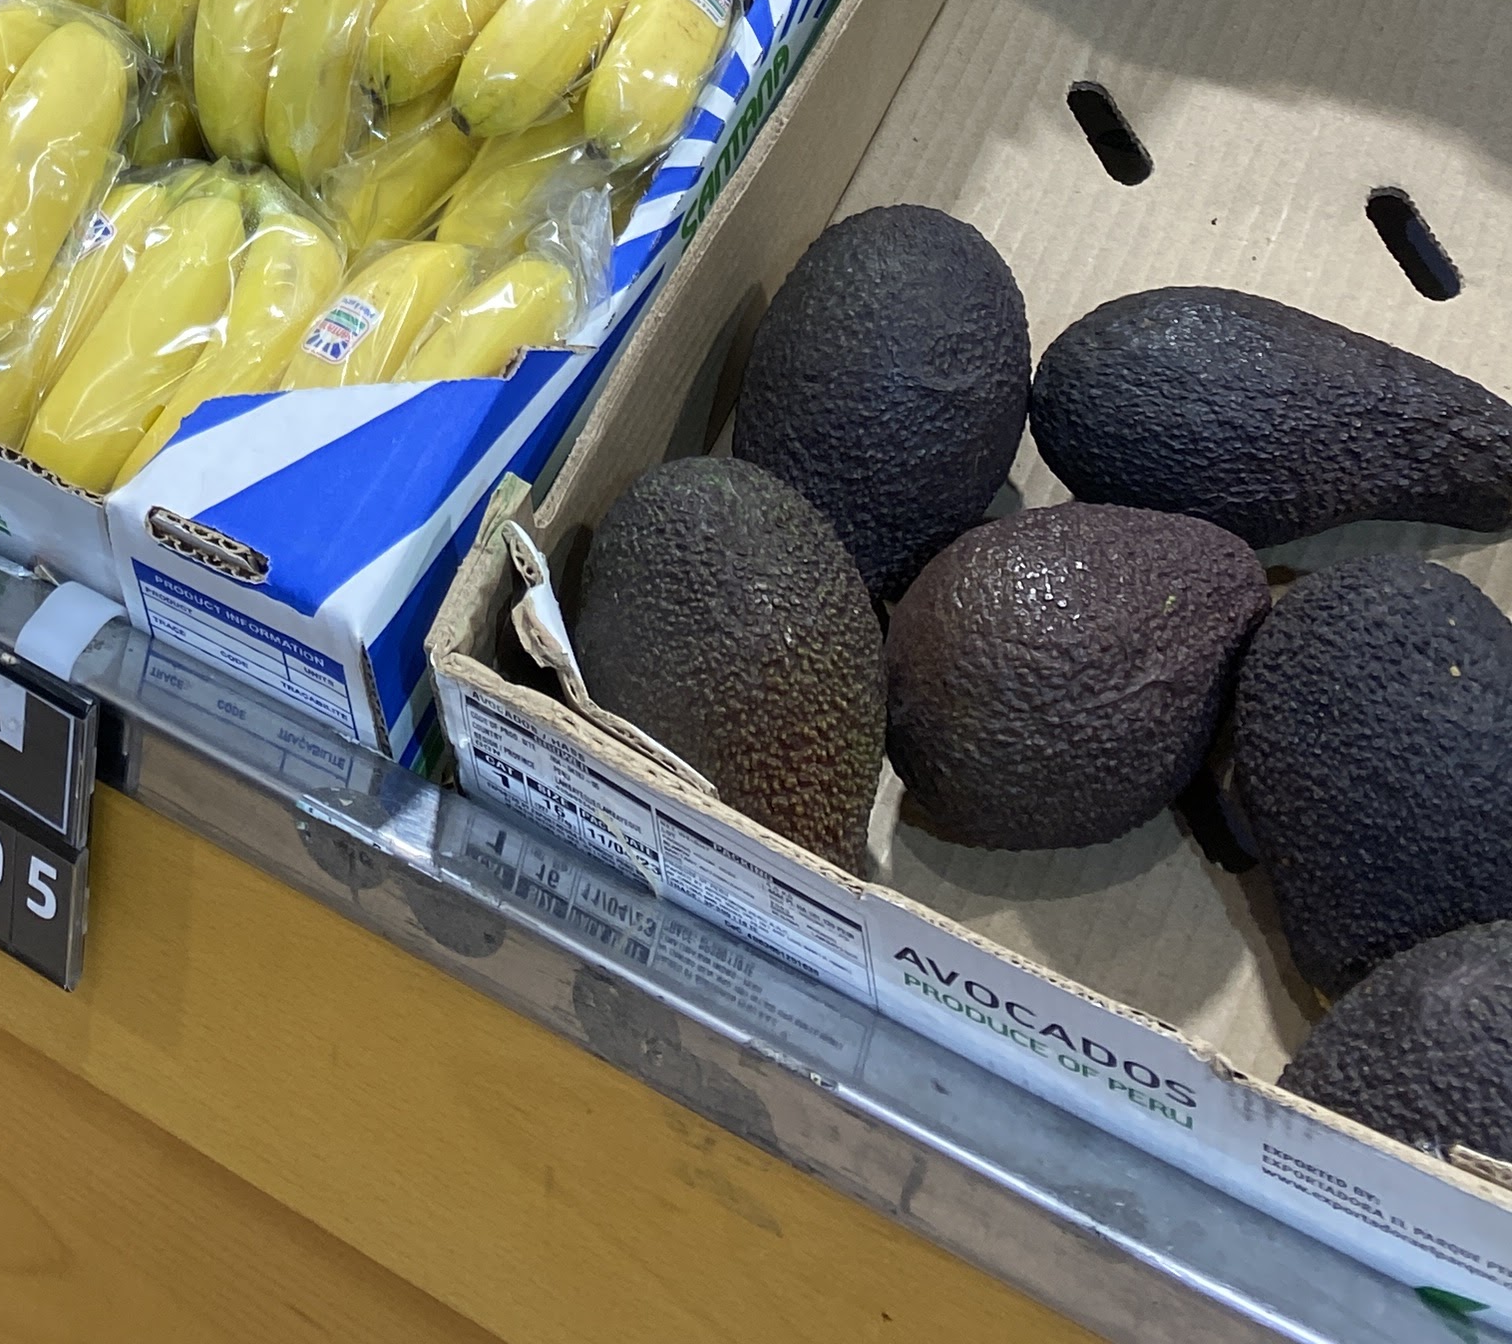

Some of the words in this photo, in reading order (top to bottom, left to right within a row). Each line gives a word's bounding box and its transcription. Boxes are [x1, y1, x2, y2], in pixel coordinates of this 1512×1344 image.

[681, 44, 790, 254] SANTANA
[143, 585, 194, 615] PRODUCT
[302, 665, 335, 688] UNITS
[152, 615, 188, 638] TRACE
[219, 650, 250, 669] CODE
[154, 574, 223, 614] PRODUCT
[225, 610, 326, 669] INFORMATION
[470, 689, 538, 734] AVOCADOS
[550, 735, 586, 763] HASS
[484, 753, 515, 777] CAT
[535, 782, 567, 808] SIZE
[490, 767, 510, 790] 1
[541, 796, 566, 820] 16
[893, 946, 1198, 1108] AVOCADOS
[904, 972, 1049, 1055] PRODUCE
[1058, 1052, 1098, 1080] OF
[1108, 1077, 1194, 1130] PERU
[1261, 1153, 1384, 1219] EXPORTADORA
[1262, 1141, 1348, 1190] EXPORTED
